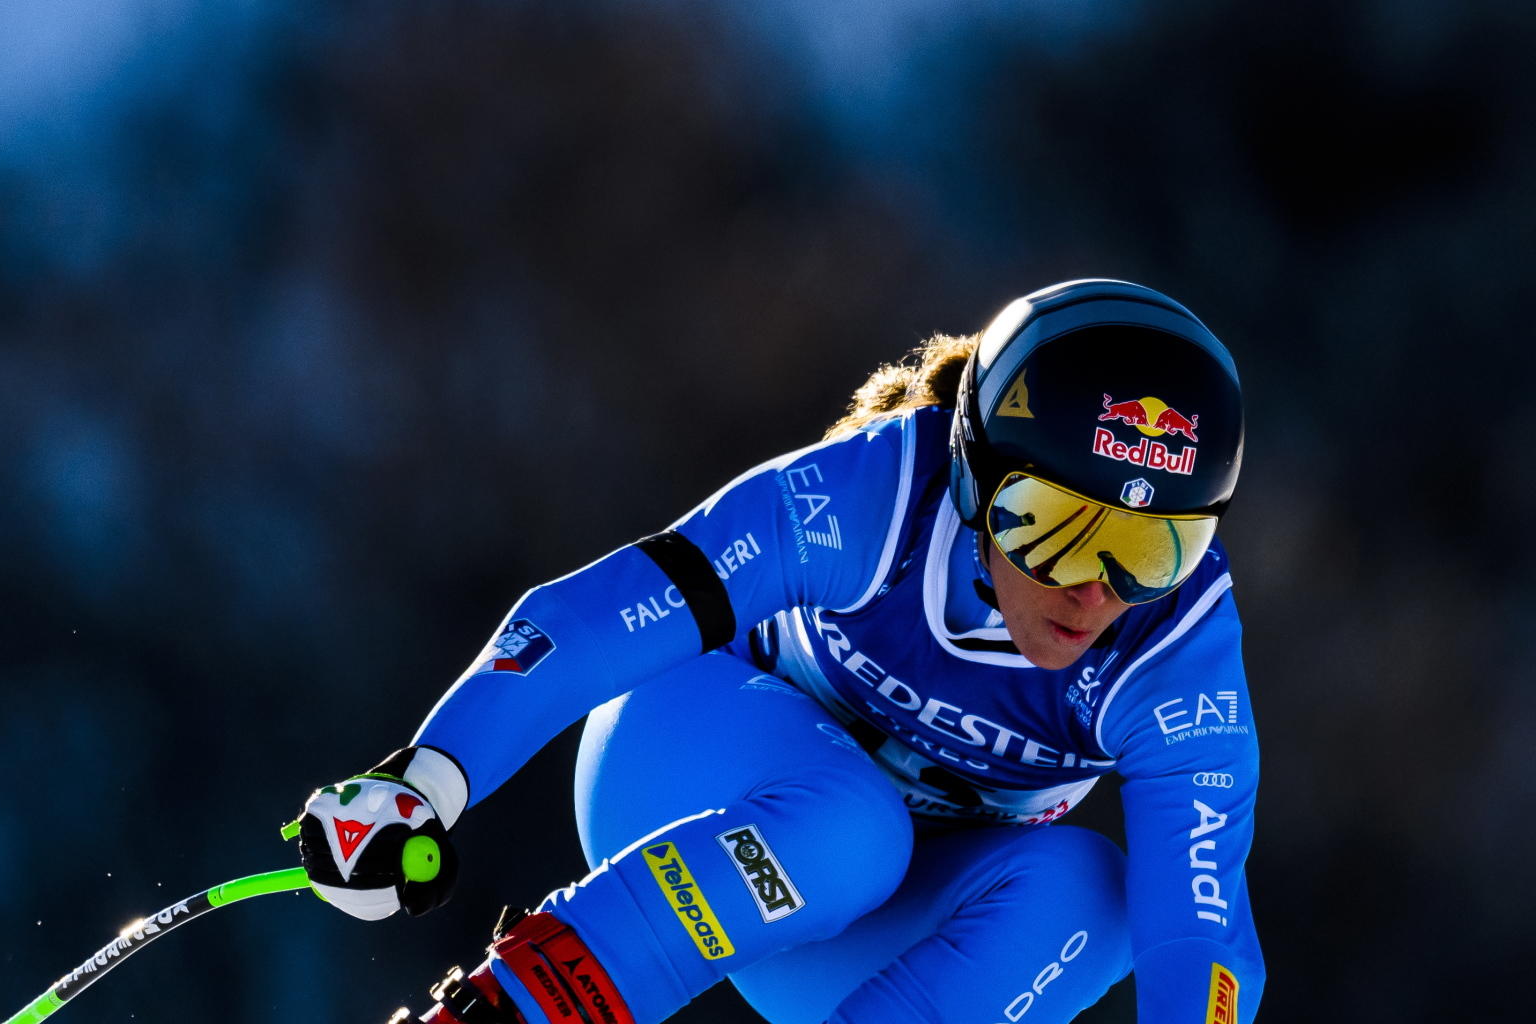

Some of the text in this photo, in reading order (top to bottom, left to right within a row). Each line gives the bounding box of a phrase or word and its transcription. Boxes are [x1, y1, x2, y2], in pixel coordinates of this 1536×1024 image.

[1093, 427, 1197, 475] Red Bull
[618, 532, 762, 633] FALCNERI
[813, 608, 1117, 770] REDESTEI
[1153, 690, 1238, 735] EA7
[659, 857, 724, 957] Telepass
[723, 828, 797, 914] FORST
[1189, 799, 1228, 928] Audi
[531, 965, 572, 1018] REDSTER
